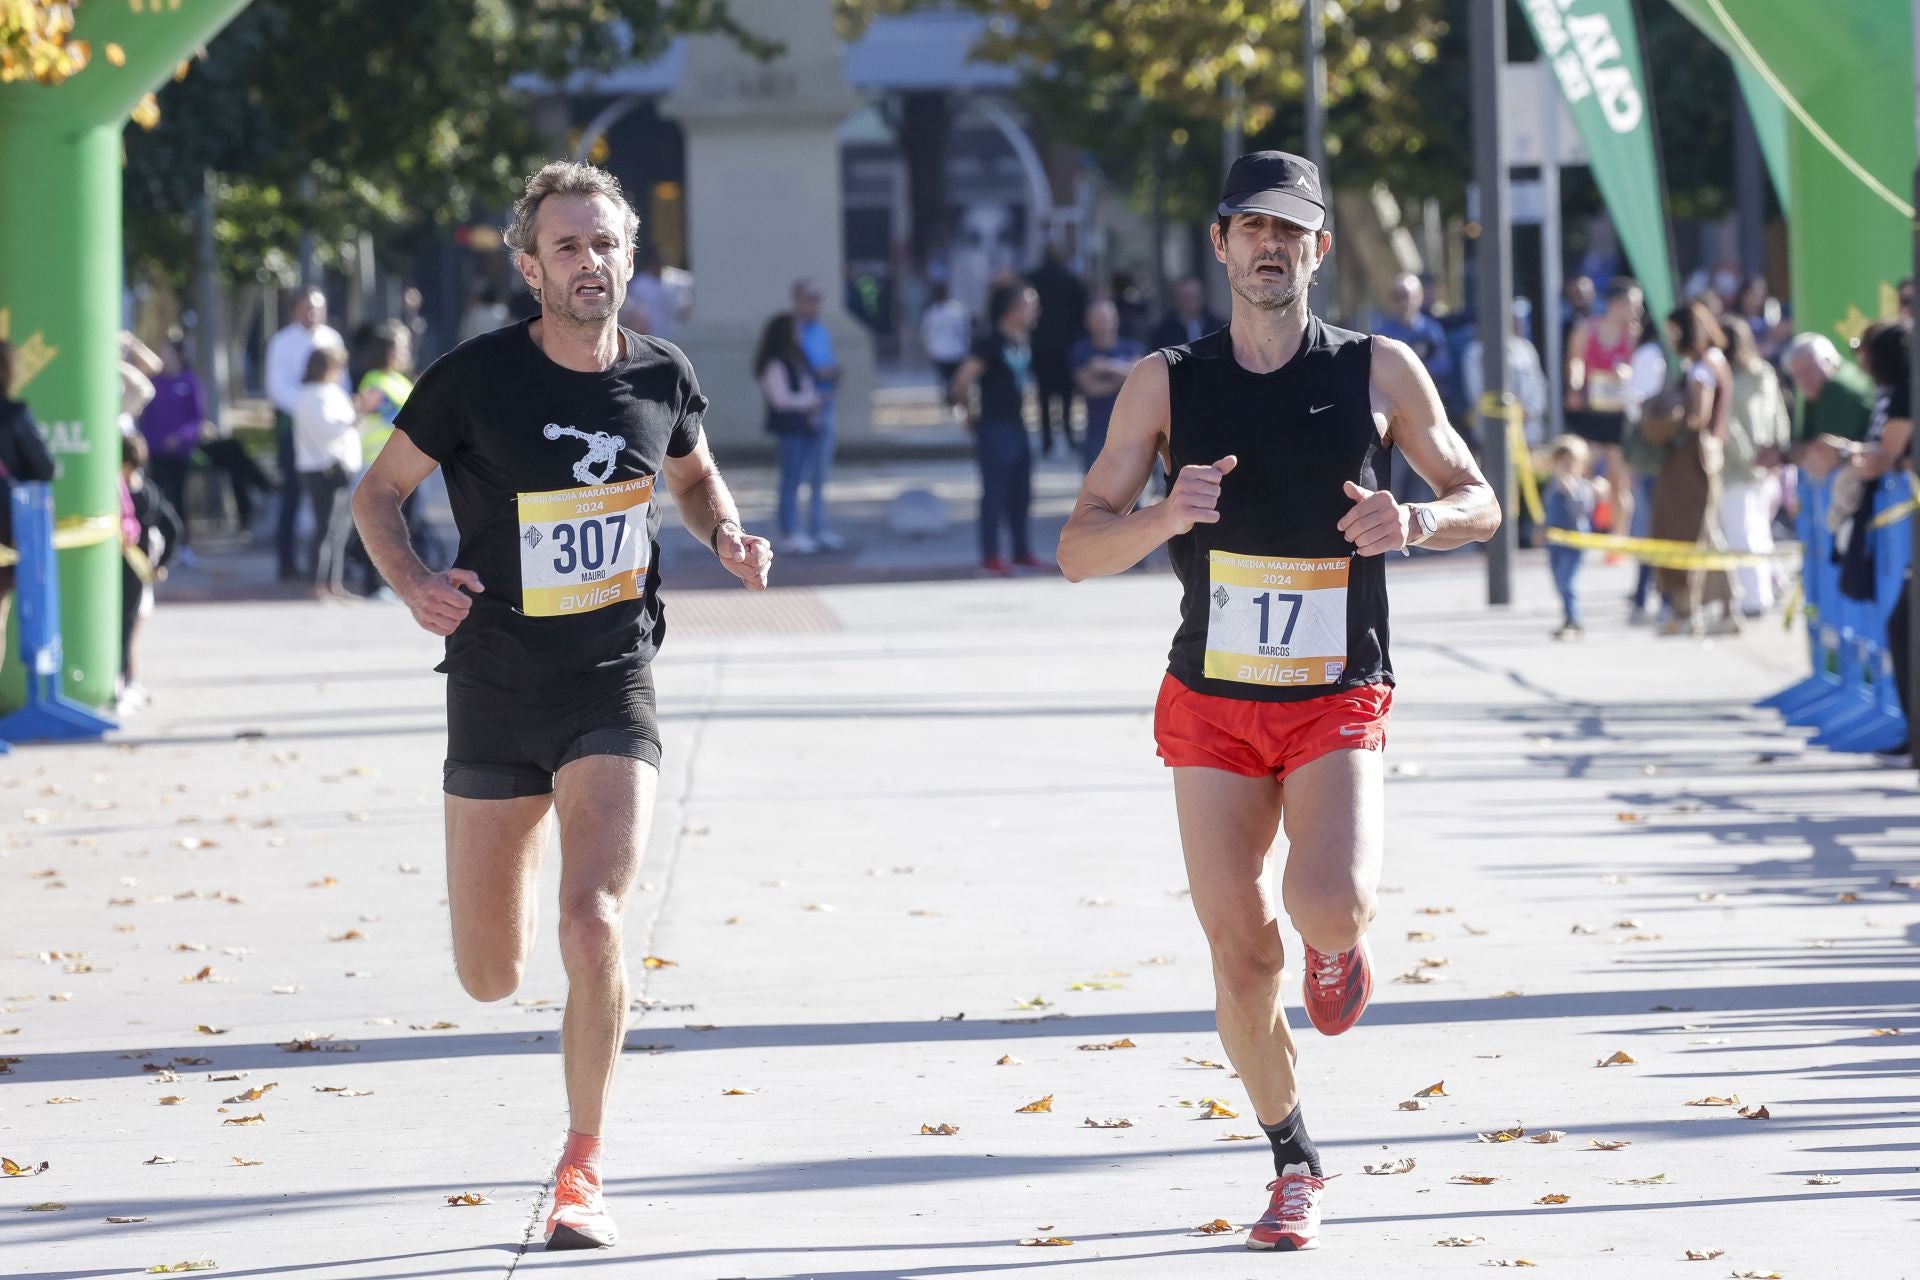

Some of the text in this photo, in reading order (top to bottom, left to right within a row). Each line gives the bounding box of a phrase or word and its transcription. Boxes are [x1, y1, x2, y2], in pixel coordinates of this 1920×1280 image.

[550, 491, 577, 502] MEDIA
[579, 485, 624, 500] MARATÓN
[625, 478, 650, 492] AVILÉS
[575, 502, 605, 514] 2024
[552, 514, 626, 574] 307
[1237, 559, 1266, 569] MEDIA
[1267, 561, 1315, 572] MARATÓN
[1316, 560, 1346, 571] AVILÉS
[581, 570, 606, 582] MAURO
[1261, 574, 1292, 585] 2024
[559, 583, 622, 610] avilés
[1252, 592, 1303, 645] 17
[1258, 646, 1290, 657] MARCOS
[1237, 663, 1310, 683] avilés
